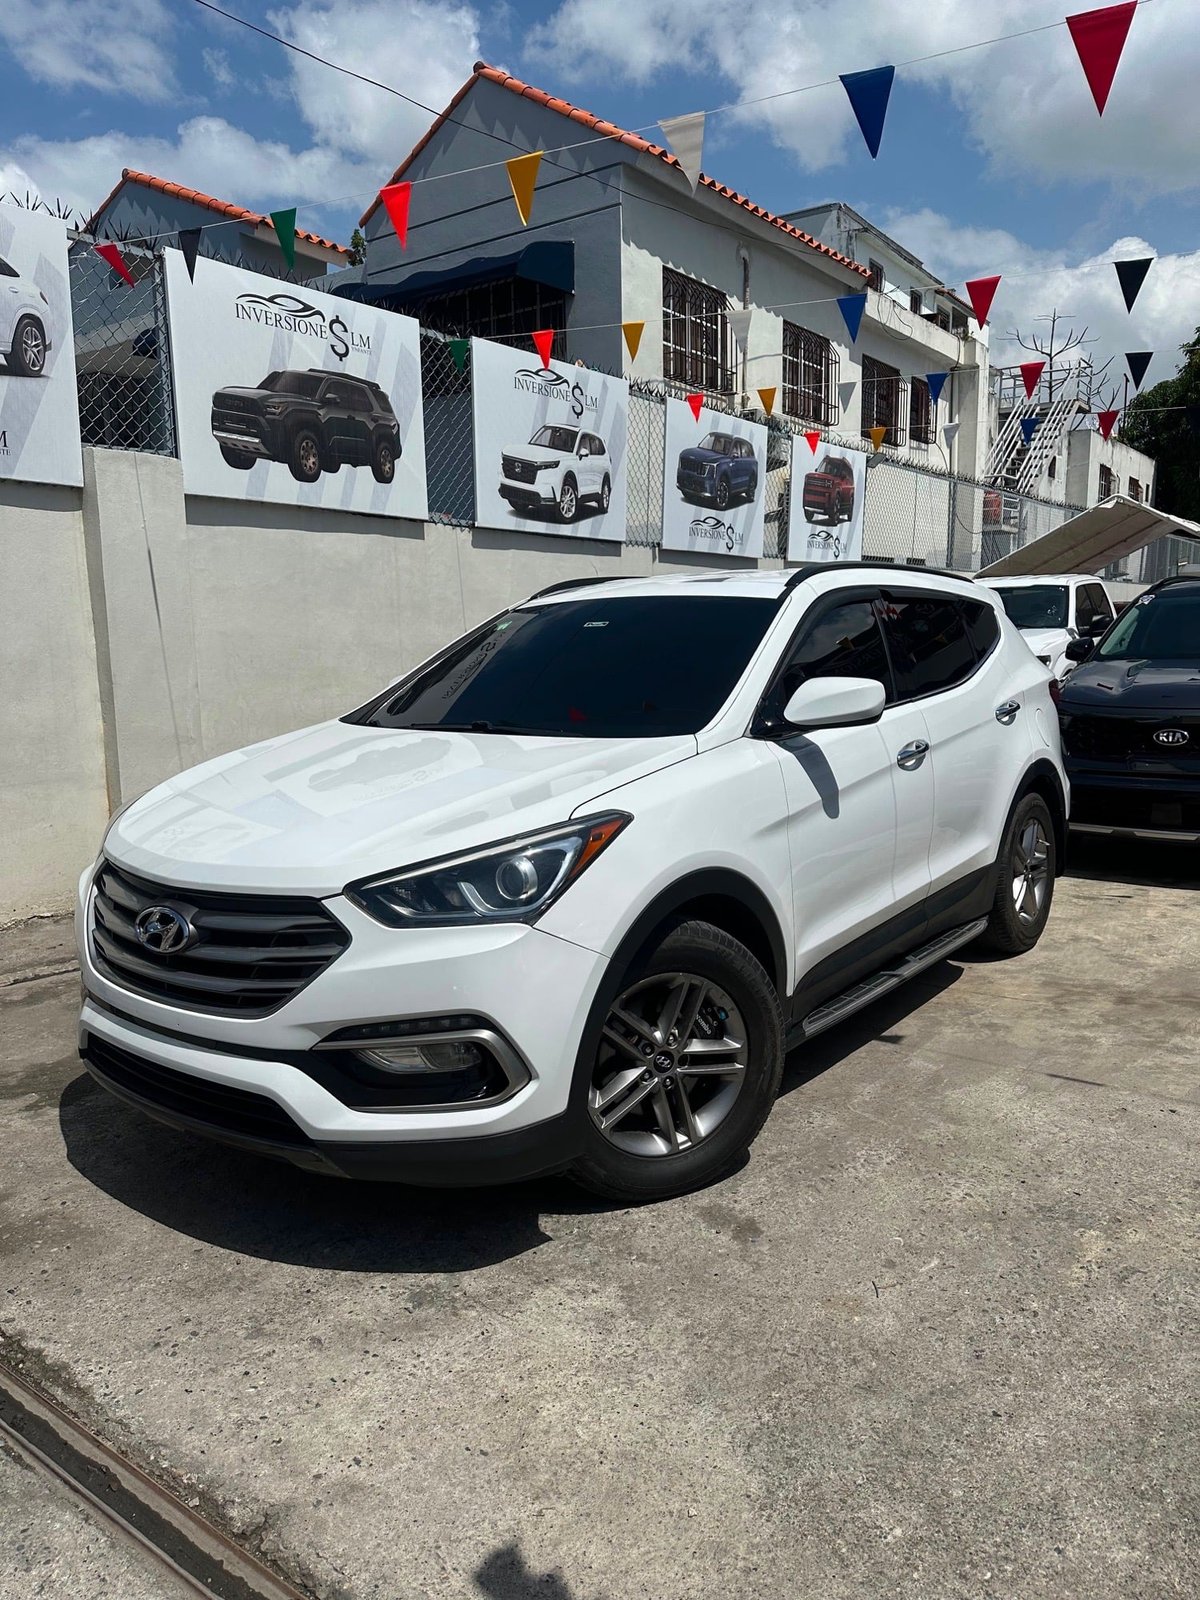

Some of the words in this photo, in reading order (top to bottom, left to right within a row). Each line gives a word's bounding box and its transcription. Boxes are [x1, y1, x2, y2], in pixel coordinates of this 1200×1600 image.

[350, 331, 371, 349] LM
[585, 394, 598, 408] LM
[1159, 732, 1183, 742] KIA
